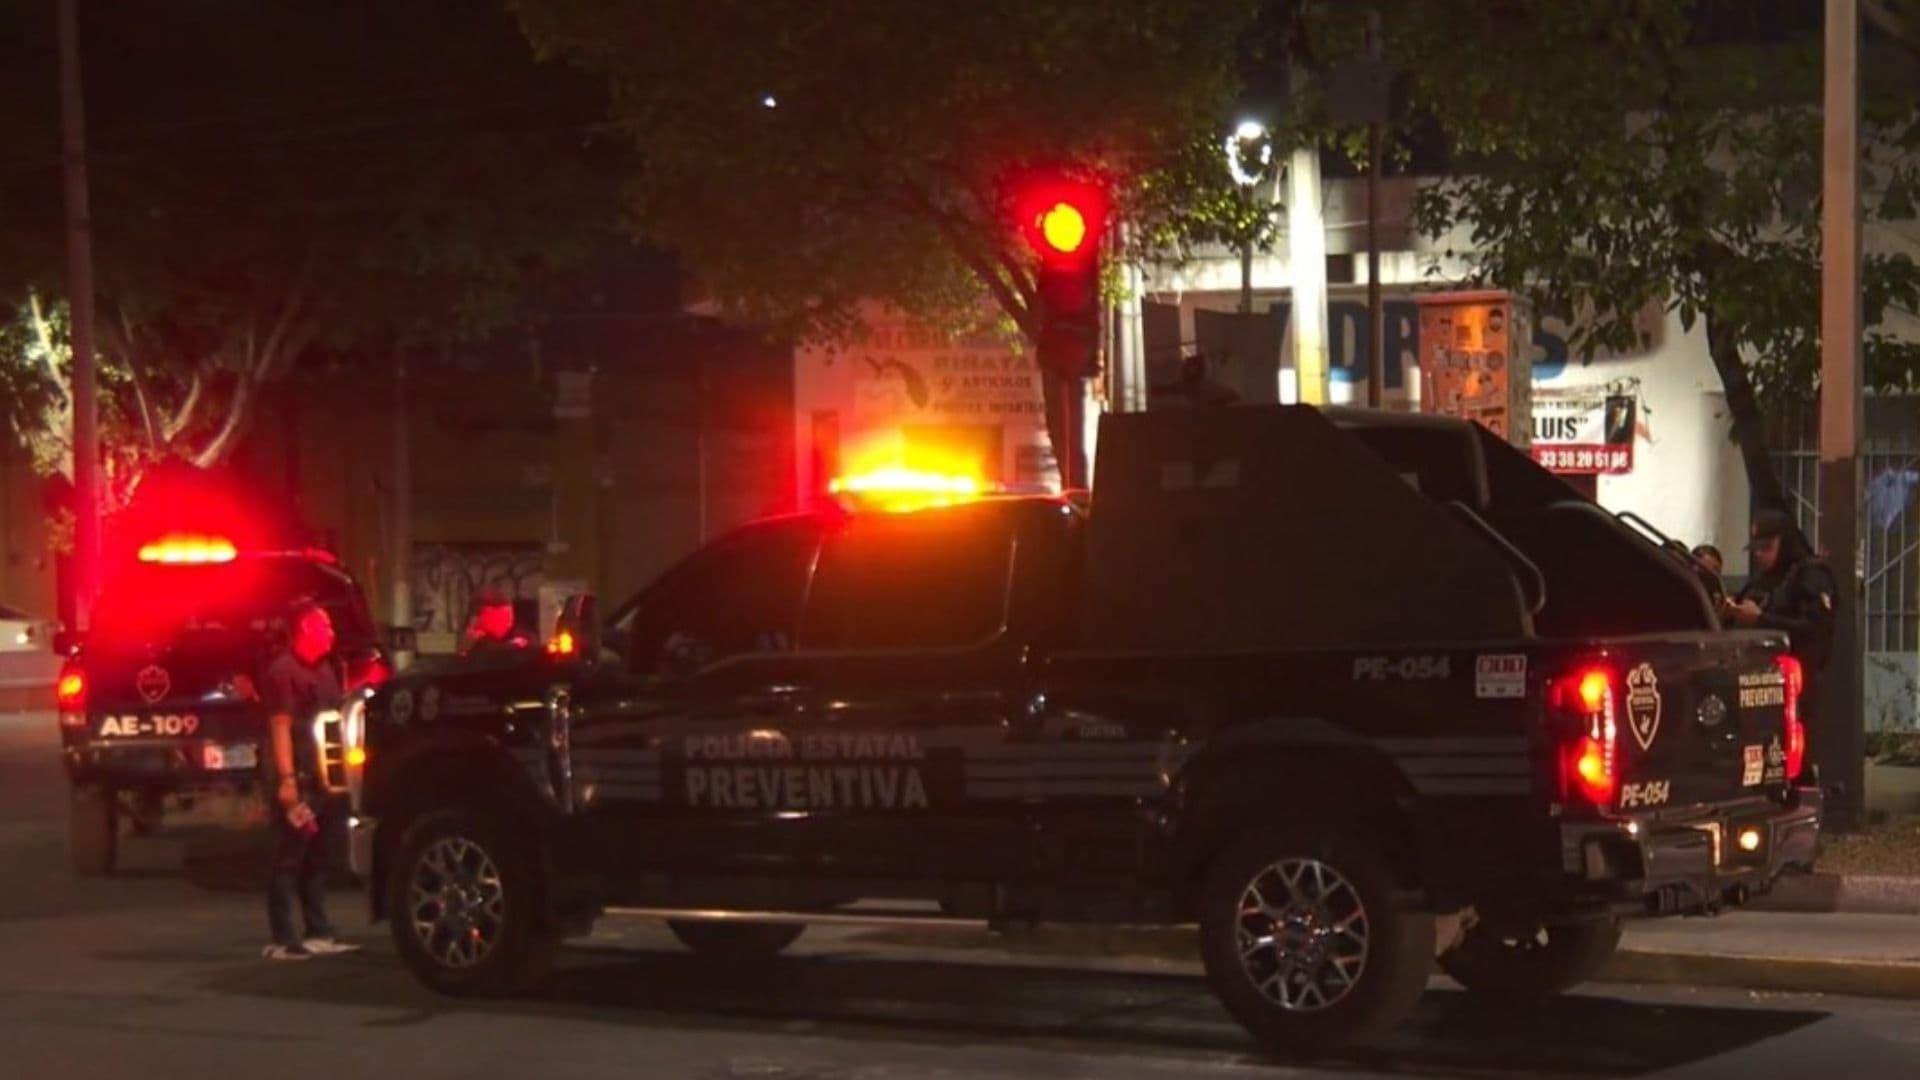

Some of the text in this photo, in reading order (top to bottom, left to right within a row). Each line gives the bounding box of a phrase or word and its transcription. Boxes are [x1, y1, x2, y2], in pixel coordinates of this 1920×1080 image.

[1352, 656, 1450, 681] PE-054
[100, 714, 199, 737] AE-109
[801, 735, 925, 759] ESTATAL
[686, 766, 928, 808] PREVENTIVA
[1620, 779, 1670, 808] PE-054
